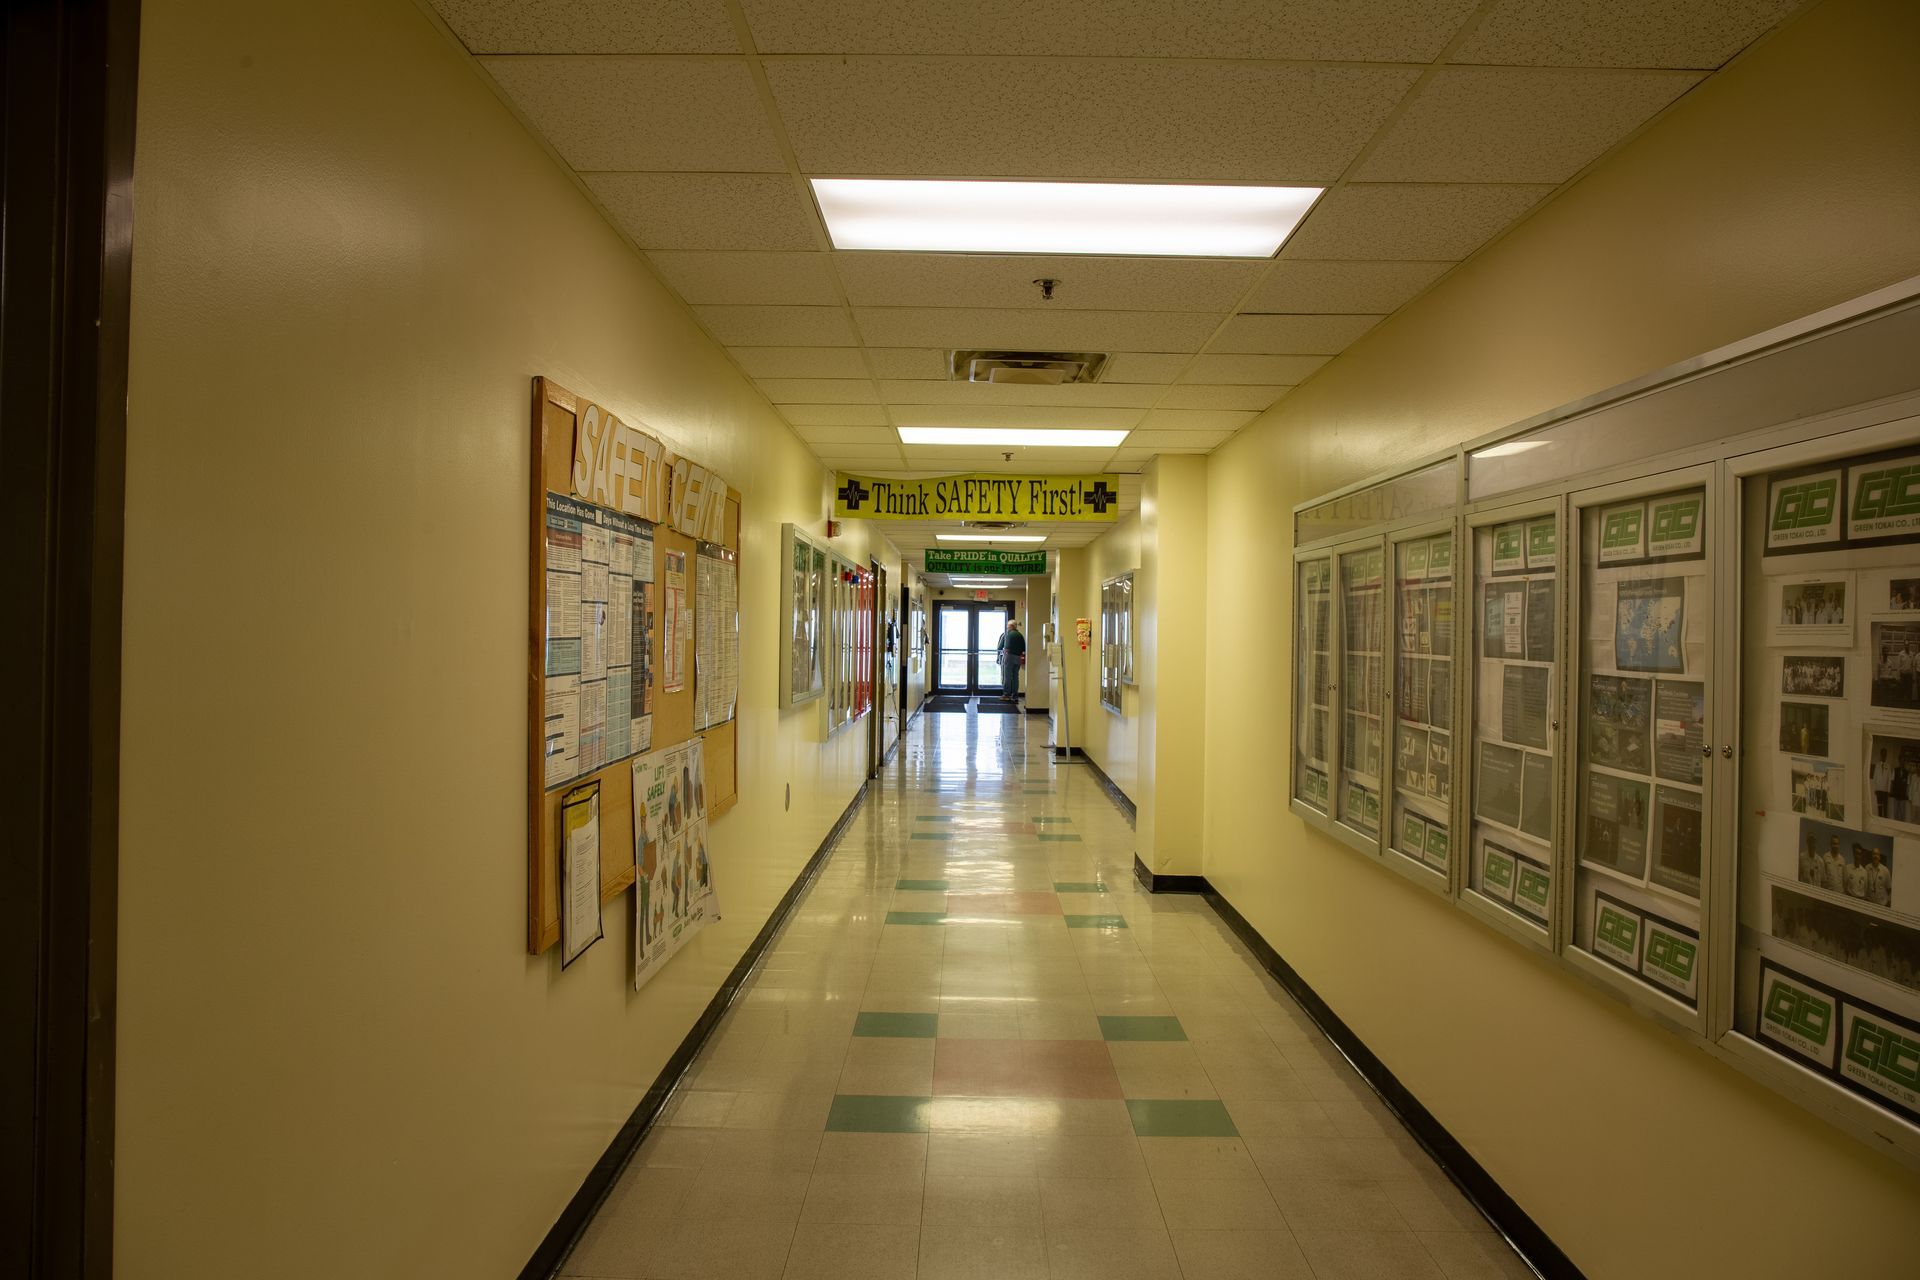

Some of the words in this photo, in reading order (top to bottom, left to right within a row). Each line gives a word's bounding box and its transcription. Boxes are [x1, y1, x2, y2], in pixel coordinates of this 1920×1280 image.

[574, 404, 666, 523] SAFETY
[872, 482, 930, 516] Think
[936, 479, 1024, 516] SAFETY
[1028, 479, 1083, 516] First!
[556, 499, 577, 515] Location
[1854, 522, 1874, 532] GREEN
[1875, 520, 1895, 530] TOKAI
[927, 551, 952, 561] Take
[954, 551, 986, 561] PRIDE
[988, 551, 997, 562] in
[1000, 551, 1046, 564] QUALITY
[927, 561, 971, 572] QUALITY
[1847, 1063, 1867, 1081] GREEN
[1867, 1072, 1887, 1090] TOKAI
